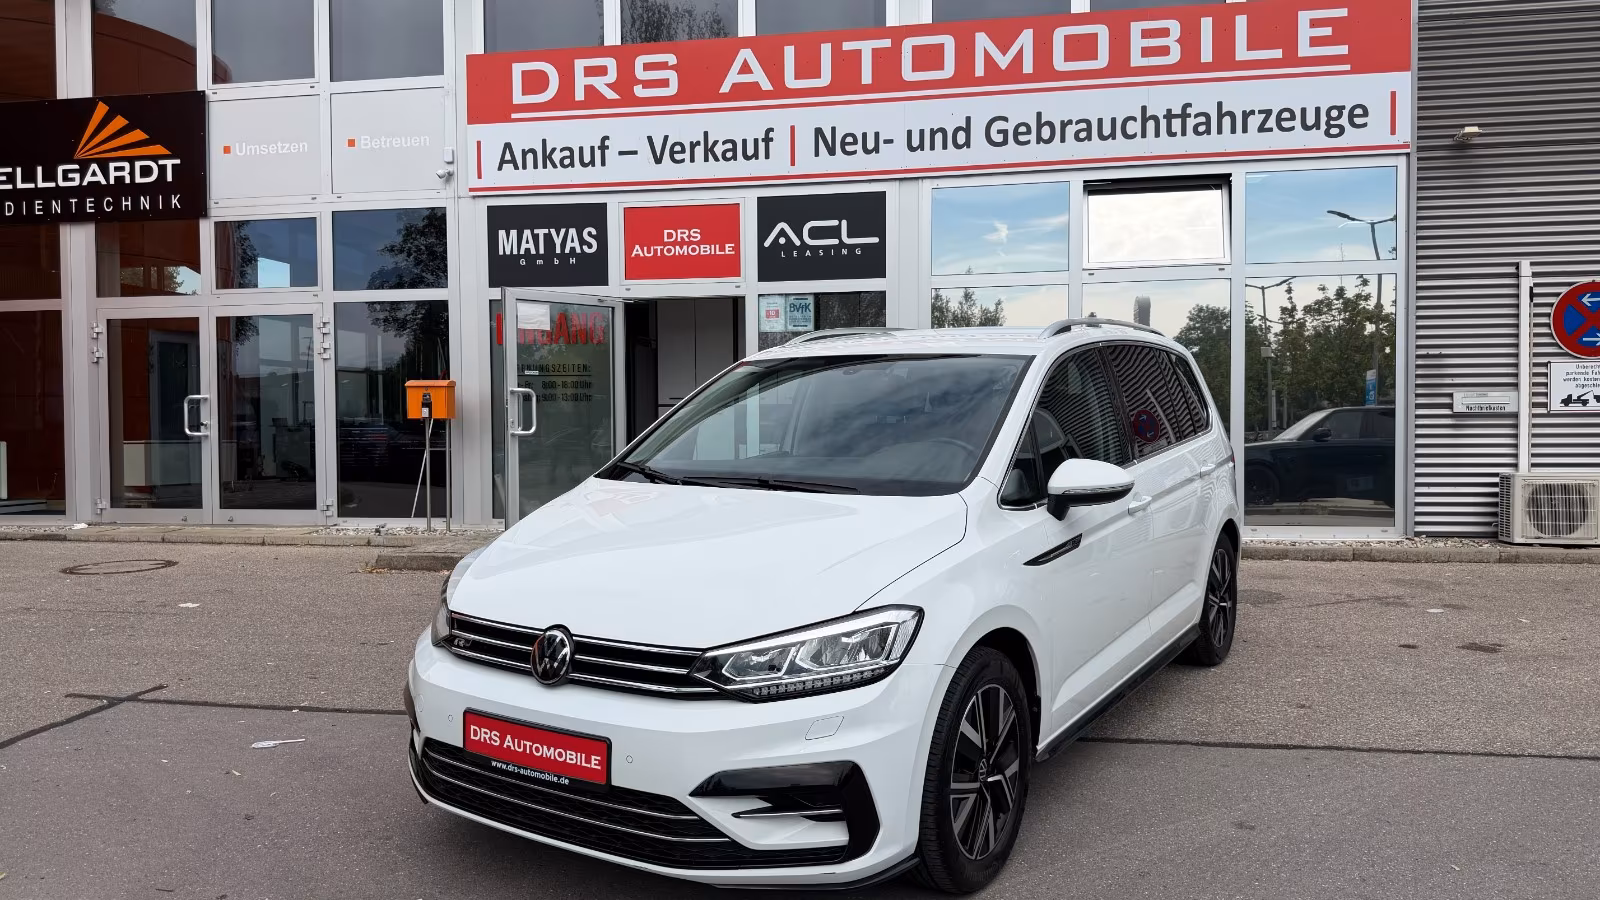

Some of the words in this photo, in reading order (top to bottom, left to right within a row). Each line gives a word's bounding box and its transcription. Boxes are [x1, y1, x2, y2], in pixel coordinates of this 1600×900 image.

[511, 53, 679, 104] DRS
[718, 8, 1350, 94] AUTOMOBILE
[235, 140, 309, 156] Umsetzen
[360, 135, 431, 149] Betreuen
[497, 136, 611, 171] Ankauf
[646, 127, 775, 165] Verkauf
[813, 125, 895, 158] Neu-
[905, 116, 972, 153] und
[984, 101, 1370, 148] Gebrauchtfahrzeuge
[5, 194, 182, 216] DIENTECHNIK
[498, 226, 598, 257] MATYAS
[663, 228, 701, 243] DRS
[763, 219, 880, 248] ACL
[631, 243, 735, 258] AUTOMOBILE
[781, 248, 862, 258] LEASING
[470, 724, 501, 746] DRS
[503, 734, 602, 770] AUTOMOBILE
[490, 759, 570, 786] www.drs-automobile.de
